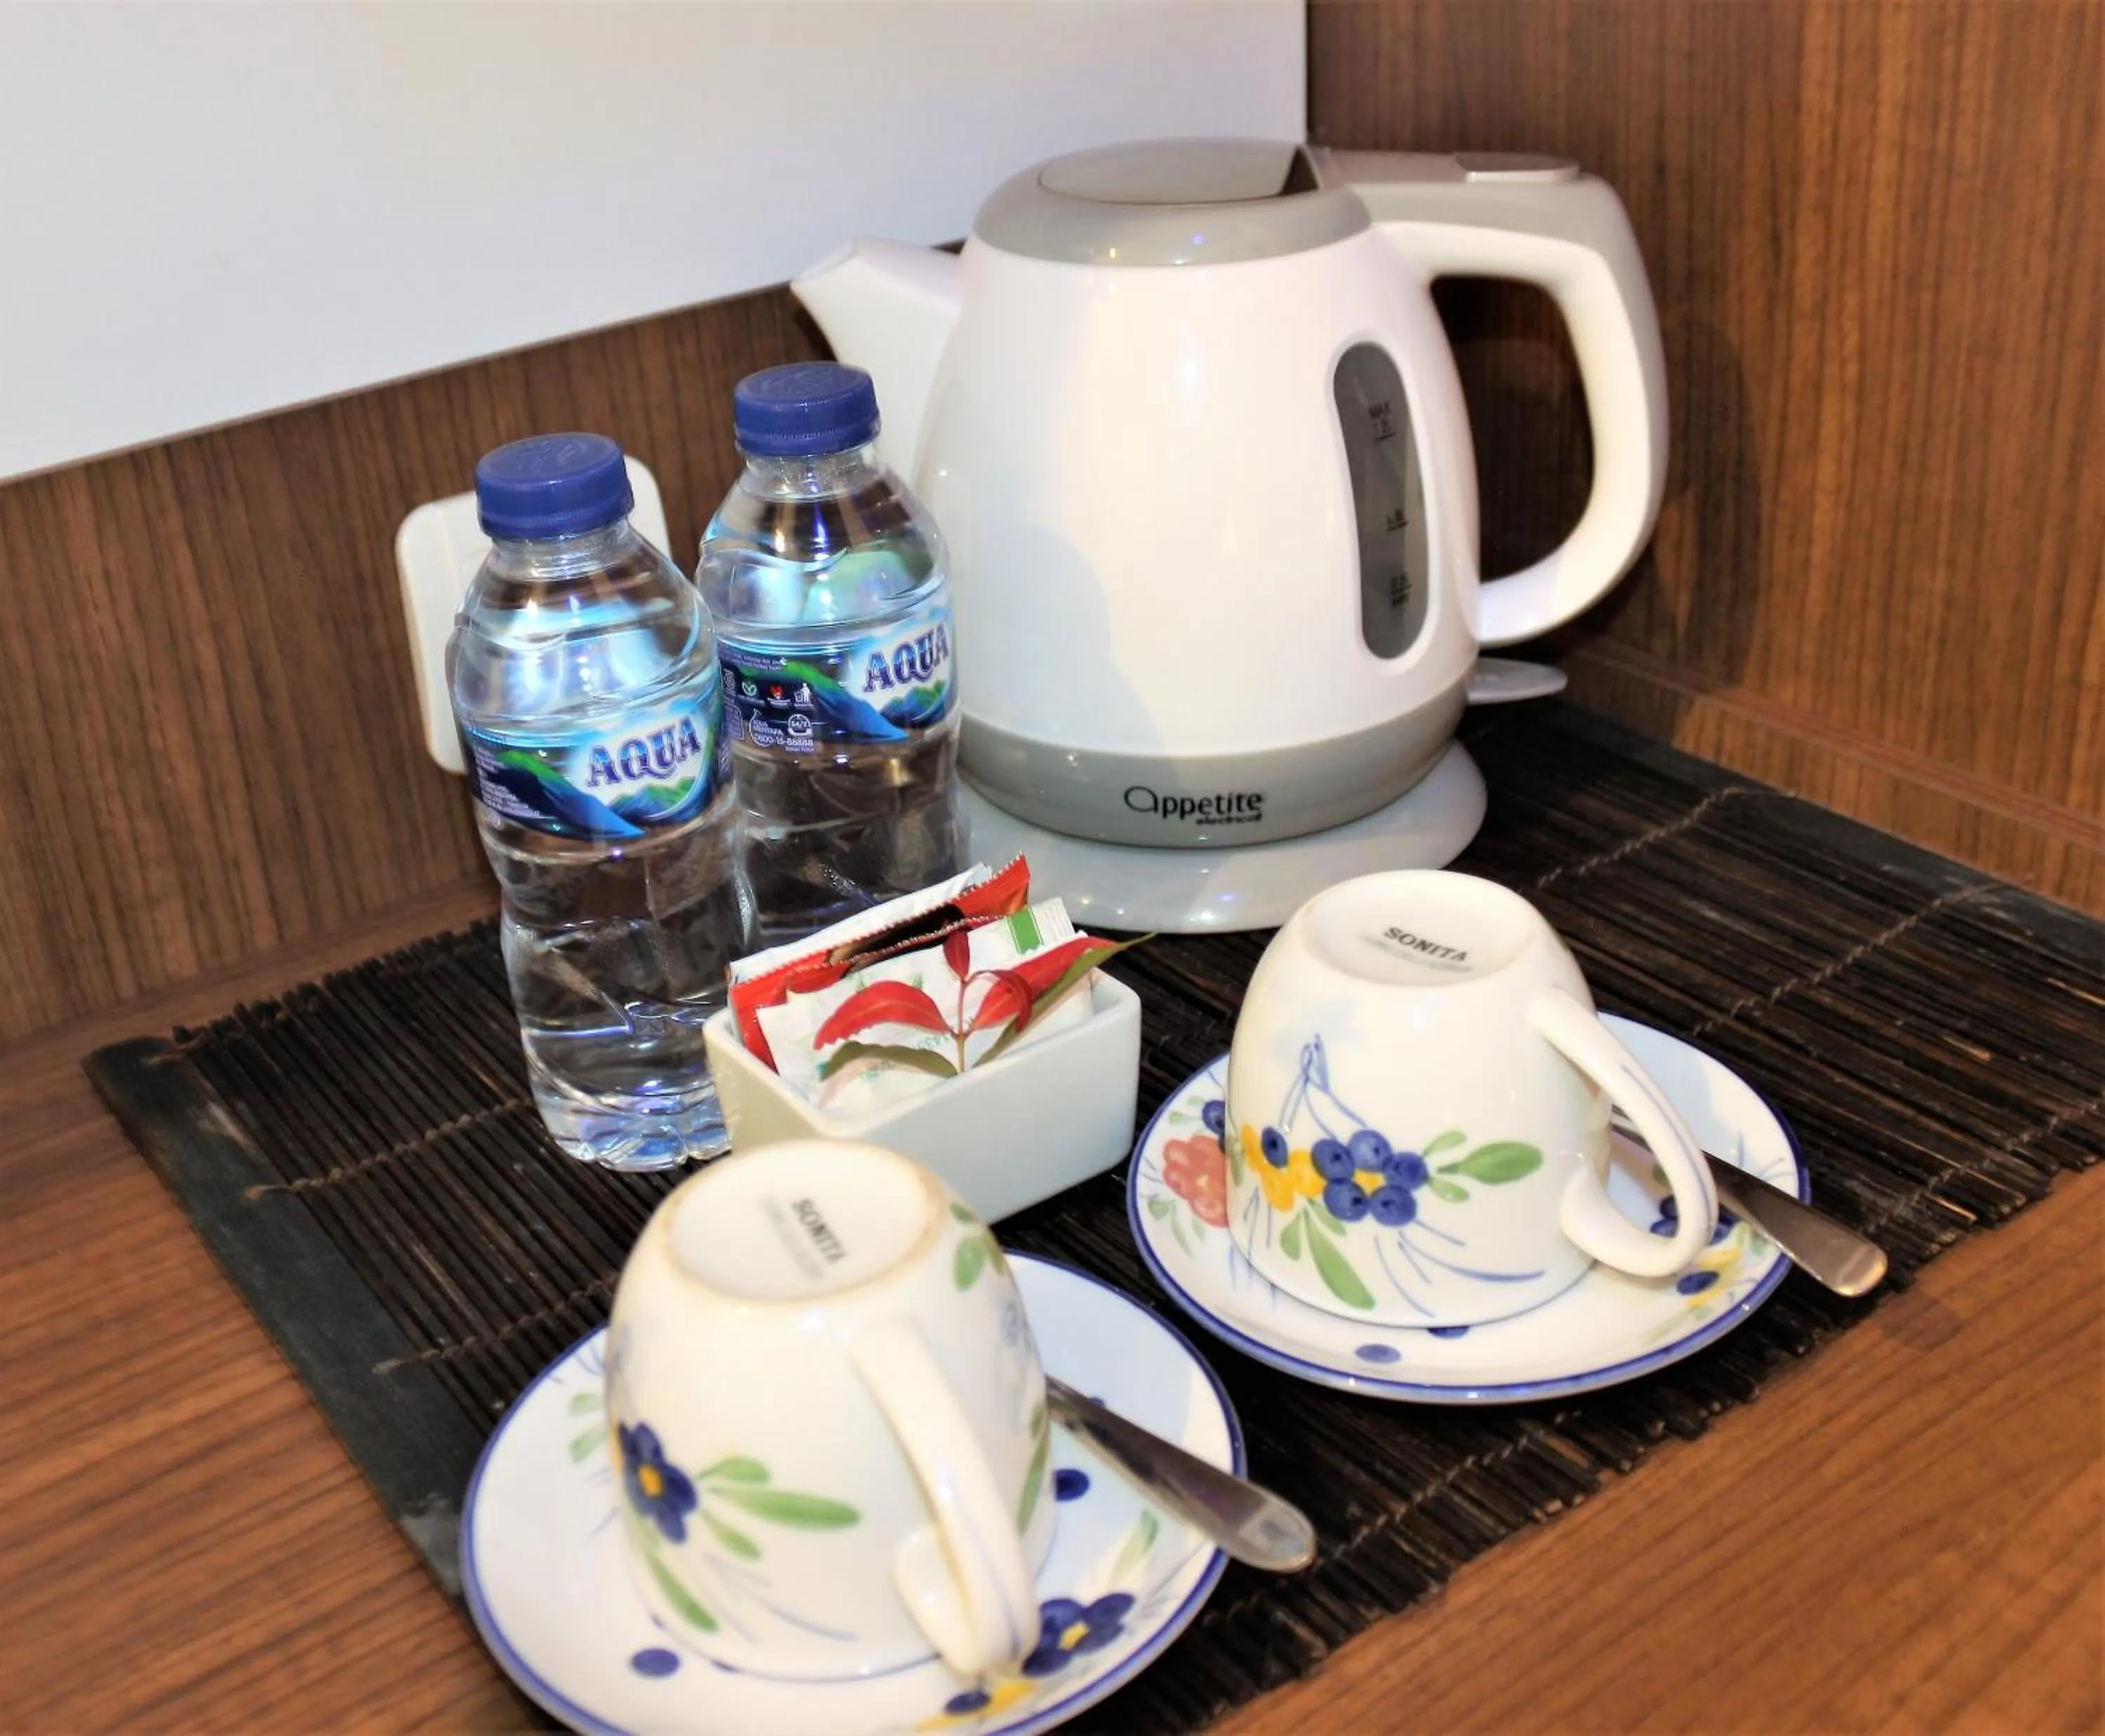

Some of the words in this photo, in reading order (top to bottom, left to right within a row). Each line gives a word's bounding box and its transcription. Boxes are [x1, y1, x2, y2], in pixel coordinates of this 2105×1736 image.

[863, 622, 949, 692] AQUA
[586, 714, 701, 787] AQUA
[1383, 926, 1468, 962] SONITA
